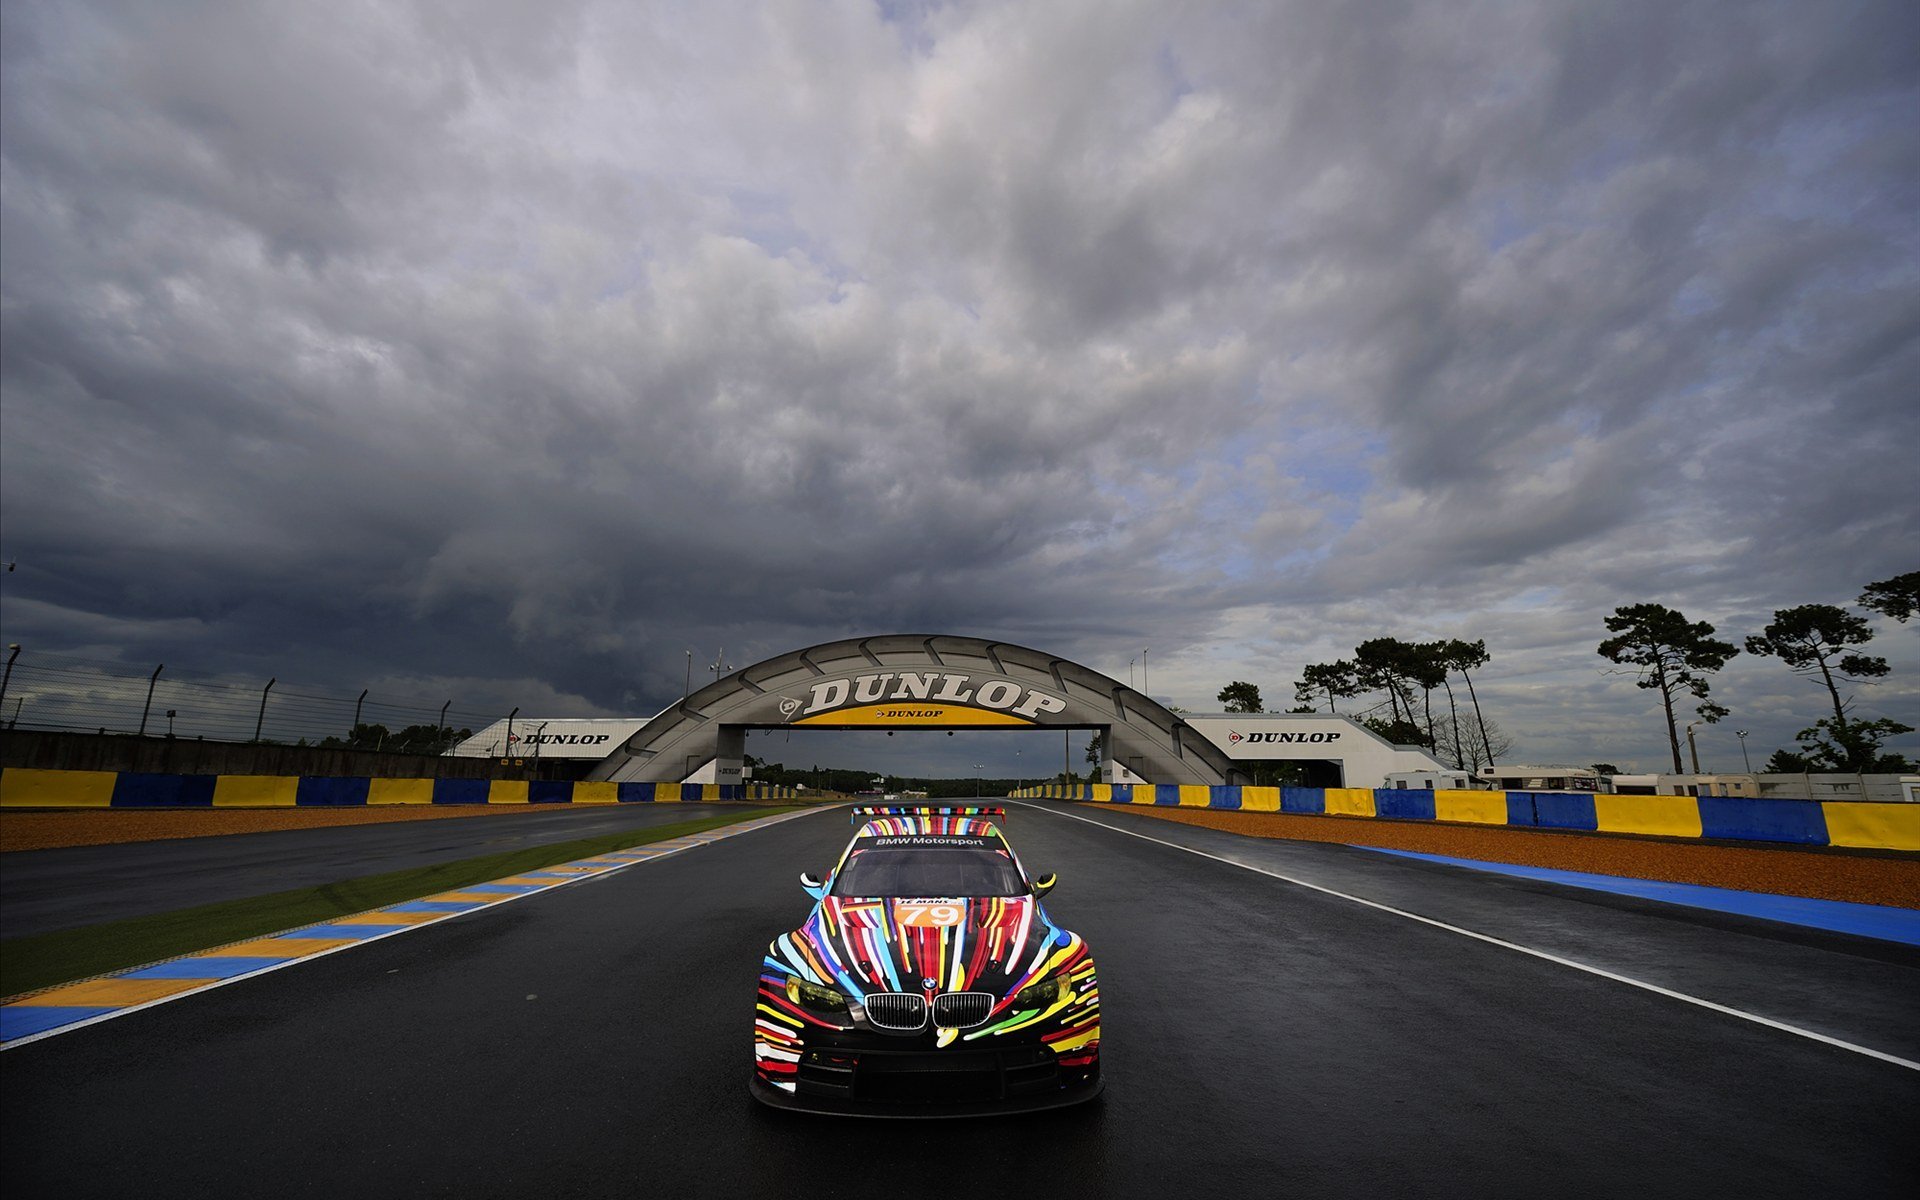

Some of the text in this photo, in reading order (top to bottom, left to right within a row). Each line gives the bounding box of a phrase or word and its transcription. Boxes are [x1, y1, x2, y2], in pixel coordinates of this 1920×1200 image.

[803, 672, 1067, 719] DUNLOP
[523, 734, 609, 744] DUNLOP
[1247, 733, 1341, 743] DUNLOP
[876, 837, 984, 846] BMW Motorsport
[901, 906, 958, 925] 79
